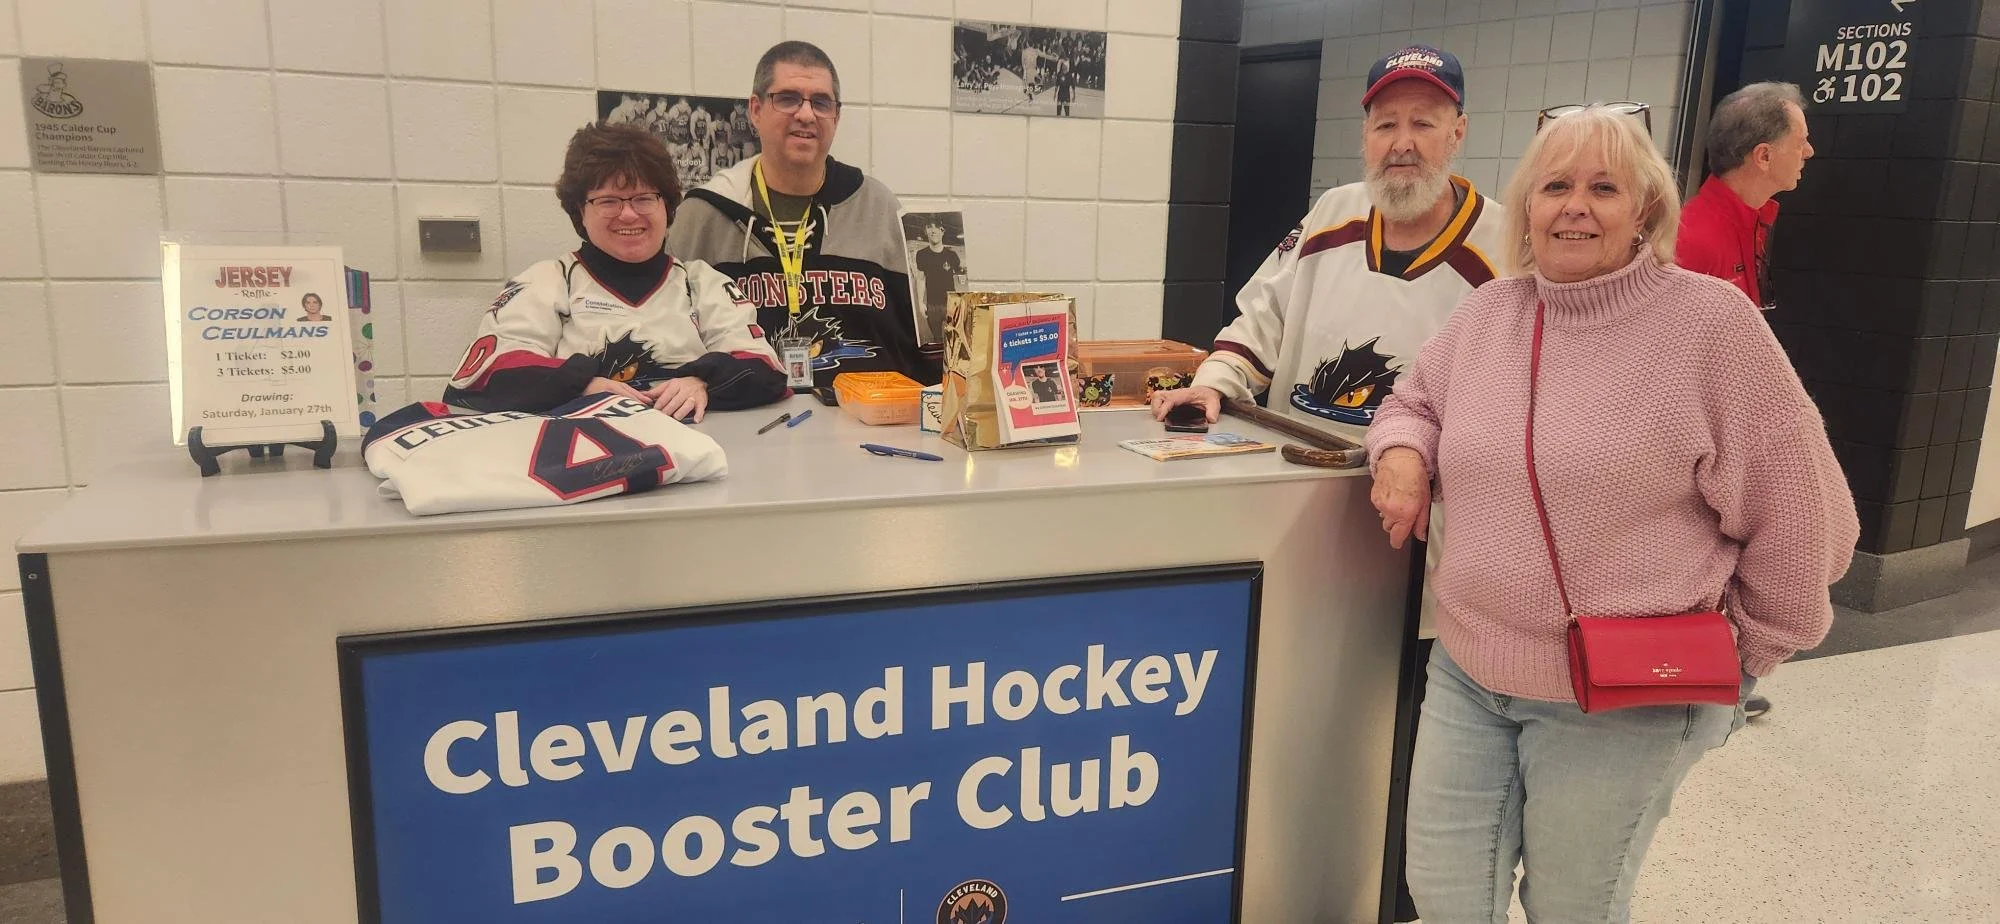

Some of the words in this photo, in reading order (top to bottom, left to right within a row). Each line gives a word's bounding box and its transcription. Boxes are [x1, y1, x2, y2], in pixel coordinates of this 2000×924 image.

[1837, 22, 1912, 40] SECTIONS
[1386, 52, 1443, 69] CLEVELAND
[1815, 40, 1908, 72] M102
[1840, 72, 1902, 103] 102
[35, 96, 80, 115] BARONS
[35, 123, 59, 132] 1945
[61, 124, 94, 133] Calder
[97, 125, 116, 134] Cup
[36, 131, 93, 142] Champions
[215, 266, 293, 289] JERSEY
[241, 289, 271, 299] Raffle
[188, 307, 287, 322] CORSON
[202, 326, 328, 341] CEULMANS
[1009, 338, 1032, 347] tickets
[1039, 333, 1059, 343] $5.00
[216, 353, 220, 361] 1
[225, 351, 267, 361] Ticket:
[281, 350, 311, 360] $2.00
[217, 368, 223, 377] 3
[227, 366, 274, 377] Tickets:
[281, 365, 312, 375] $5.00
[241, 392, 293, 403] Drawing:
[202, 409, 257, 420] Saturday,
[259, 406, 304, 417] January
[307, 404, 332, 414] 27th
[528, 417, 675, 500] 4
[423, 664, 906, 794] Cleveland
[931, 644, 1219, 729] Hockey
[508, 780, 932, 904] Booster
[956, 735, 1160, 831] Club
[947, 883, 998, 905] CLEVELAND
